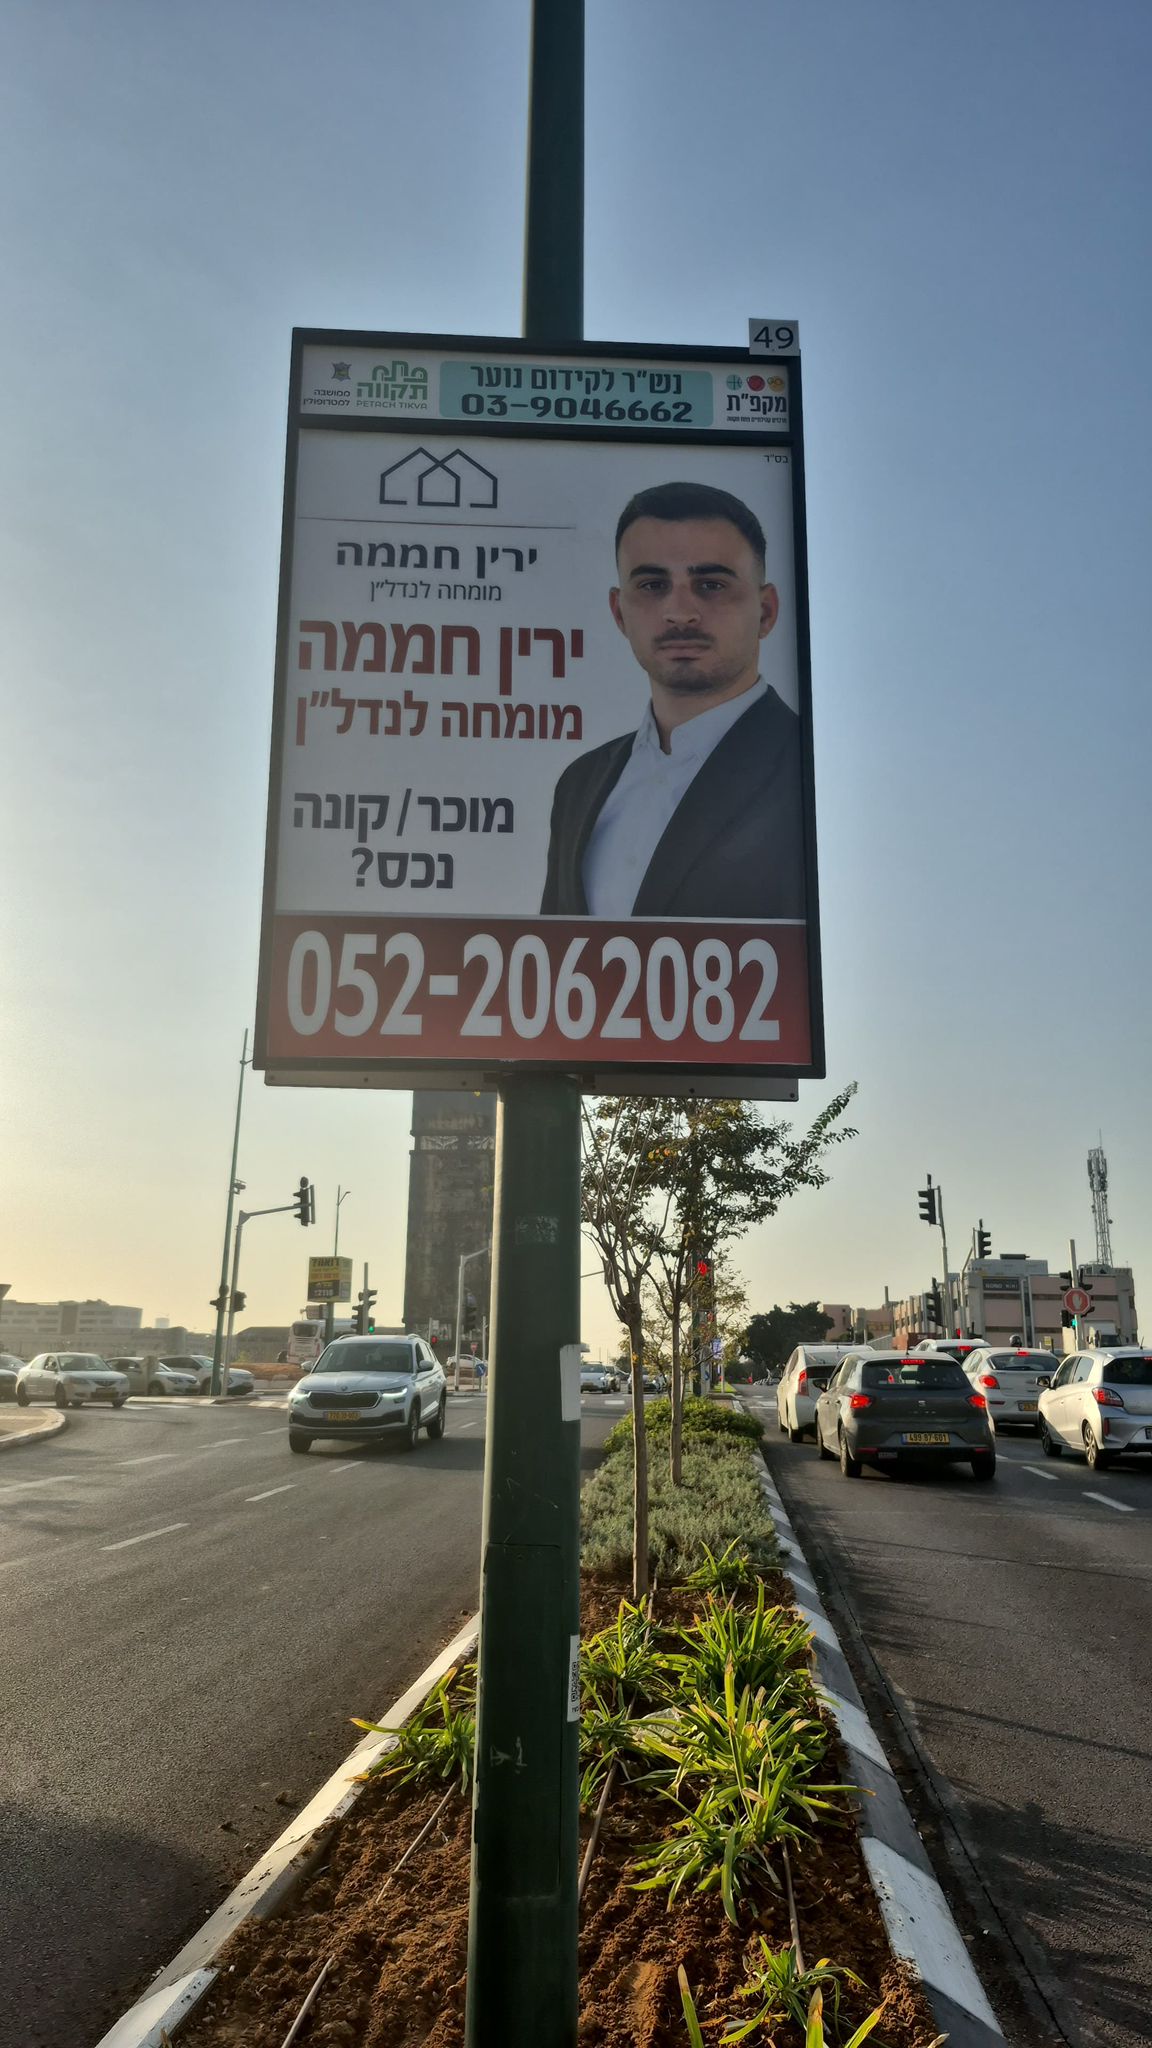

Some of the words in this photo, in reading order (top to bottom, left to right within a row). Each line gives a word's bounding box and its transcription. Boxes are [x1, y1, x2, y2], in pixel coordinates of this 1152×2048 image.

[753, 326, 794, 349] 49
[357, 382, 428, 400] תקווה
[470, 366, 522, 388] נוער
[531, 367, 614, 395] לקידום
[622, 369, 682, 394] נש"ר
[303, 398, 351, 407] למטרופולין
[313, 389, 351, 398] ממושבה
[356, 400, 396, 409] PETACH
[726, 393, 787, 415] מקפ"ת
[461, 393, 693, 423] 03-9046662
[336, 541, 460, 570] חממה
[476, 546, 538, 579] ירין
[370, 579, 431, 602] לנדל"ן
[438, 582, 502, 602] מומחה
[298, 620, 481, 676] חממה
[499, 626, 584, 696] ירין
[295, 687, 429, 746] לנדל"ן
[441, 702, 583, 740] מומחה
[293, 788, 515, 843] מוכר/קונה
[351, 847, 454, 889] נכס?
[287, 930, 780, 1043] 052-2062082
